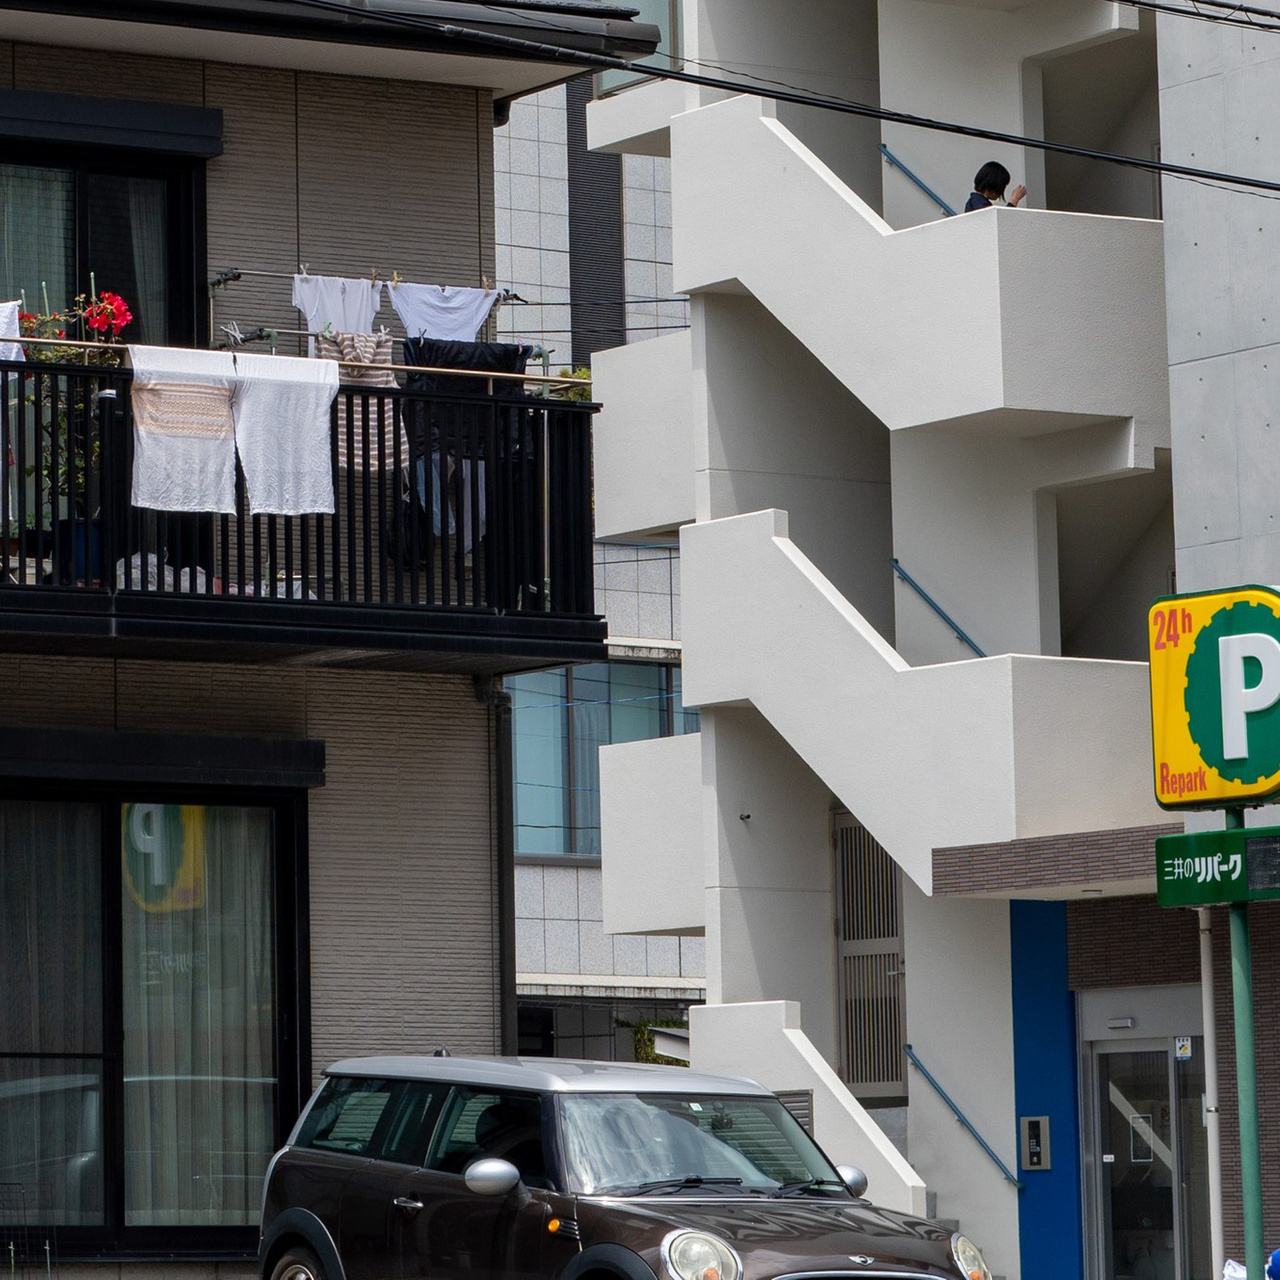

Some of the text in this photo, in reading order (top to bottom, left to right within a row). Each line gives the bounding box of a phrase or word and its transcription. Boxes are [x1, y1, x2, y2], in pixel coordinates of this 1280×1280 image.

[1153, 608, 1192, 650] 24h
[1218, 633, 1280, 760] P
[1160, 762, 1207, 797] Repark
[1164, 853, 1242, 883] 三井のリパーク
